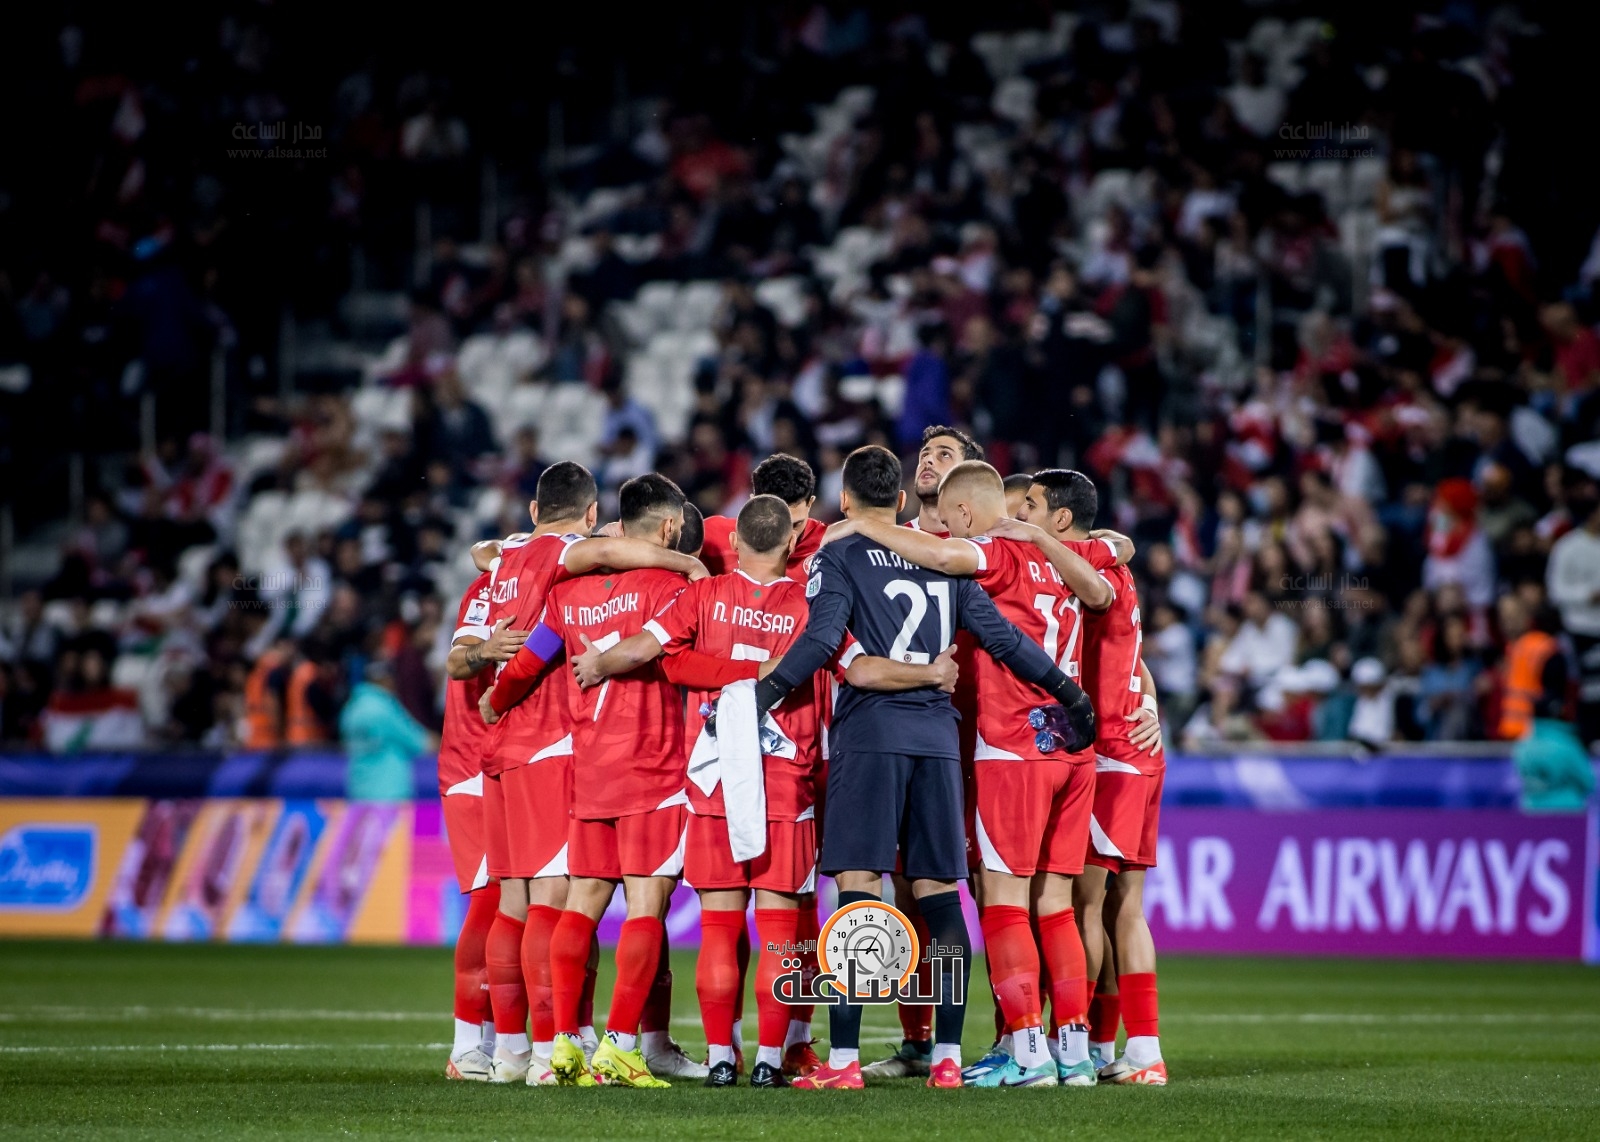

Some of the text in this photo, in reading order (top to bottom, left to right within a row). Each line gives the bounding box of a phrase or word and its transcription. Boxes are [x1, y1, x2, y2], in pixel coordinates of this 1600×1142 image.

[1028, 561, 1046, 583] R.
[564, 592, 638, 626] H. MAATOUK
[713, 601, 795, 634] N. NASSAR
[884, 579, 951, 666] 21
[1034, 593, 1080, 677] 12
[1257, 837, 1570, 935] AIRWAYS
